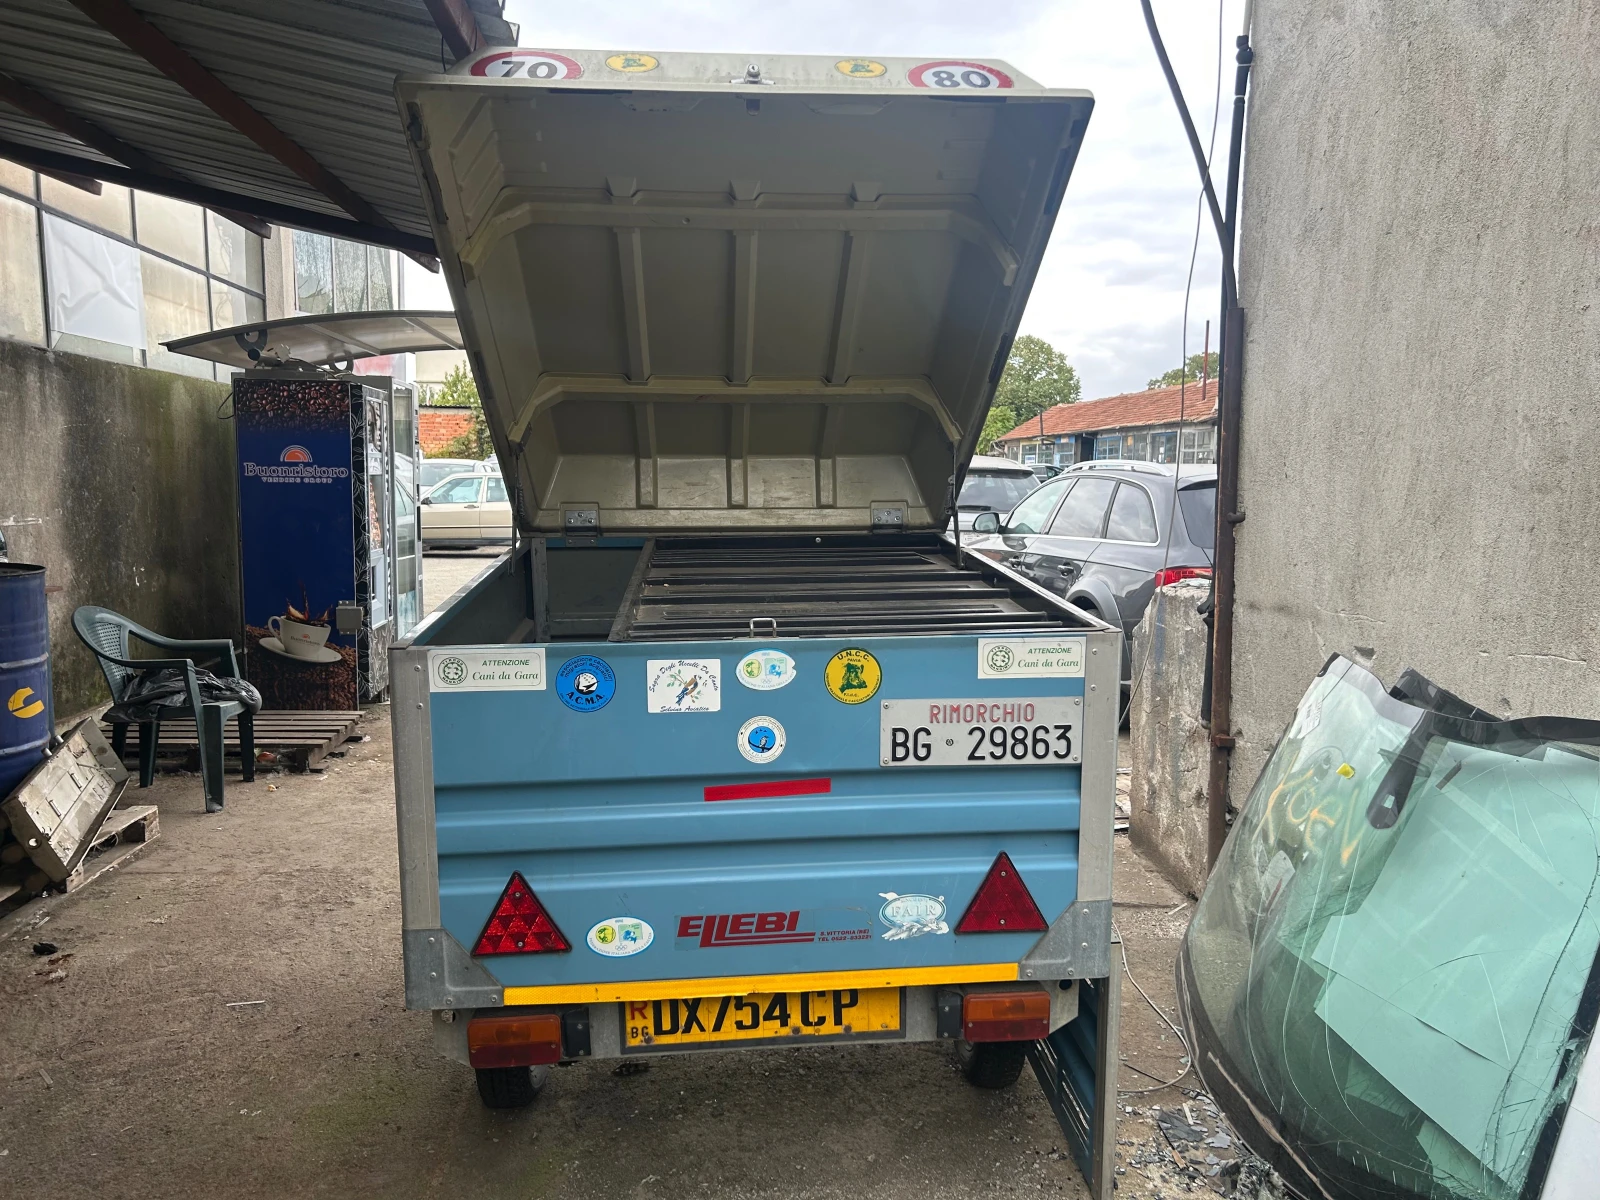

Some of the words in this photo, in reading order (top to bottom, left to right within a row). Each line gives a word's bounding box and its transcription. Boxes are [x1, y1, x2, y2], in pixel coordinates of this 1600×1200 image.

[501, 60, 558, 79] 70
[932, 71, 990, 88] 80
[243, 462, 349, 478] Buonristoro
[482, 659, 530, 667] ATTENZIONE
[837, 651, 869, 662] U.N.C.C.
[1018, 659, 1038, 668] Cani
[1042, 659, 1053, 667] da
[1056, 658, 1079, 667] Gara
[472, 671, 495, 681] Cani
[498, 671, 510, 680] da
[514, 670, 539, 680] Gara
[566, 692, 604, 705] A.C.M.A.
[929, 702, 1035, 724] RIMORCHIO
[891, 726, 932, 762] BG
[967, 724, 1072, 761] 29863
[677, 910, 816, 948] ELLEBI
[630, 1000, 648, 1020] R
